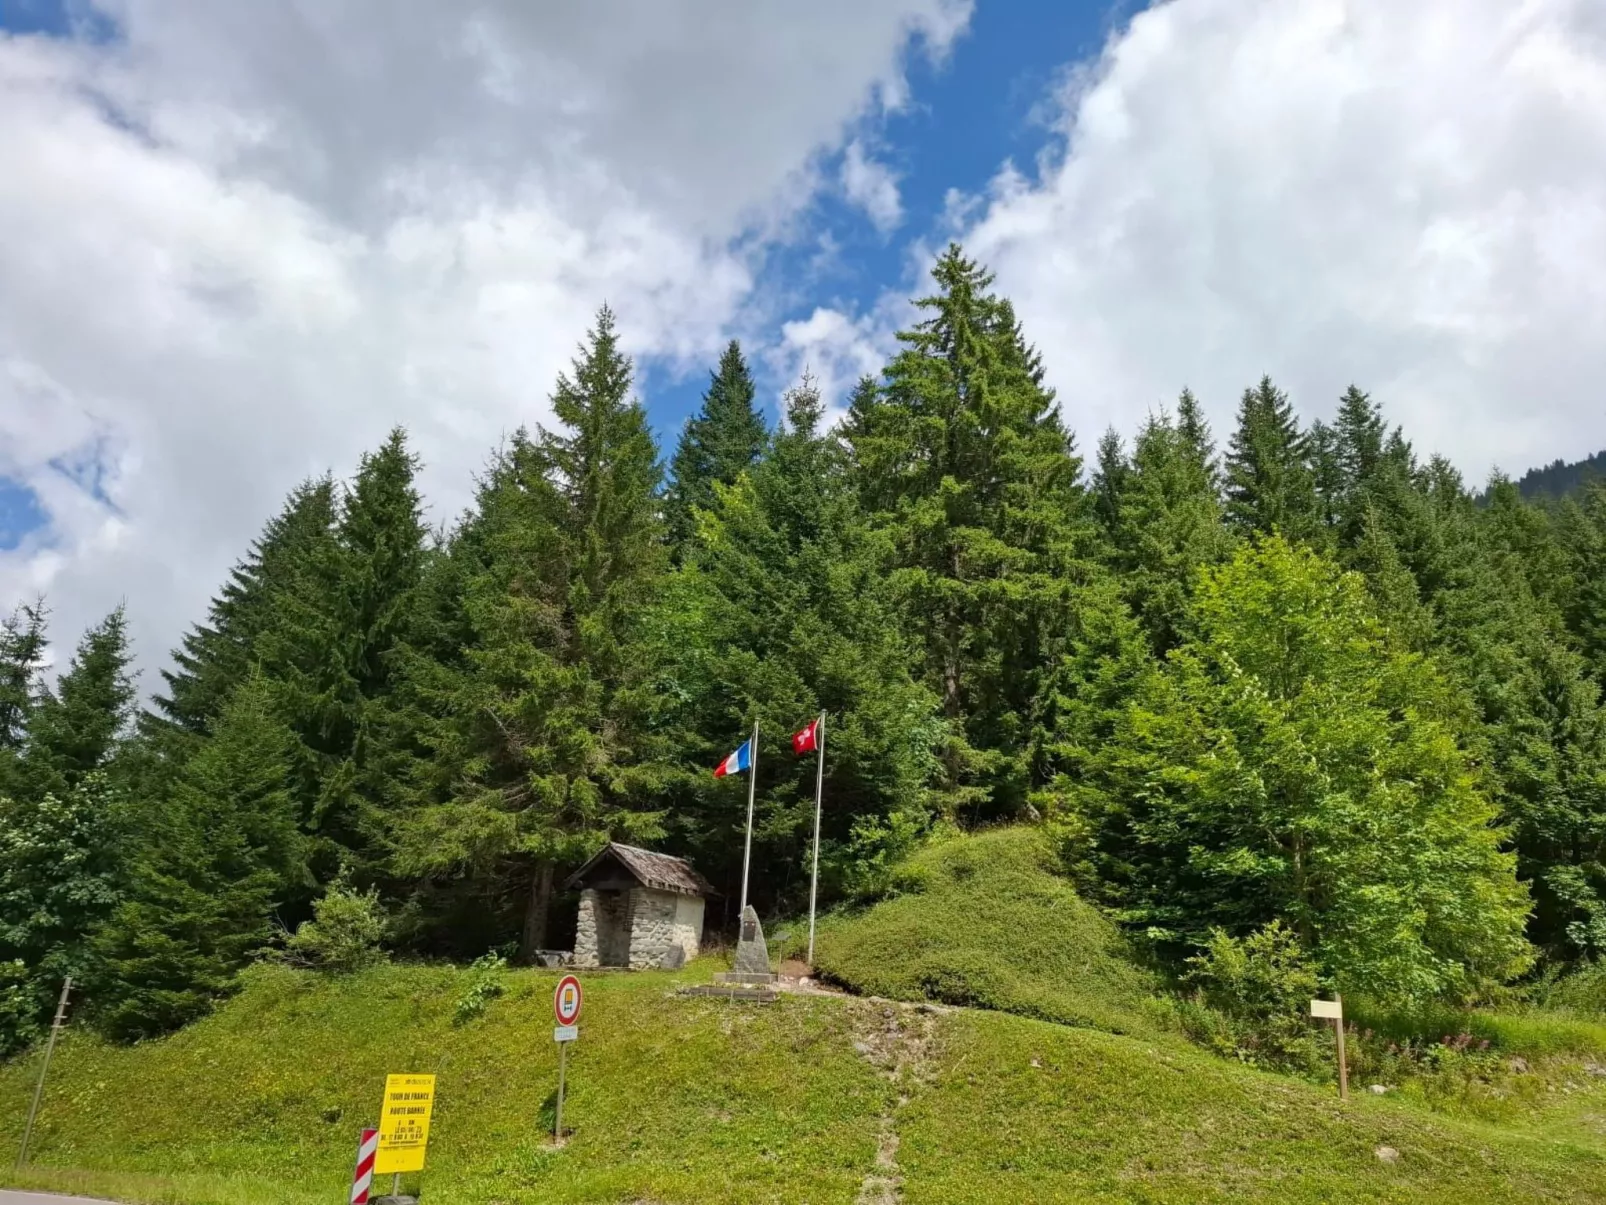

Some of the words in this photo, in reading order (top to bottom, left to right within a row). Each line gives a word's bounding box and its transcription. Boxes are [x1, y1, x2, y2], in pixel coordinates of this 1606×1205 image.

[390, 1092, 404, 1101] TOUR
[411, 1092, 429, 1100] FRANCE
[390, 1106, 407, 1115] ROUTE
